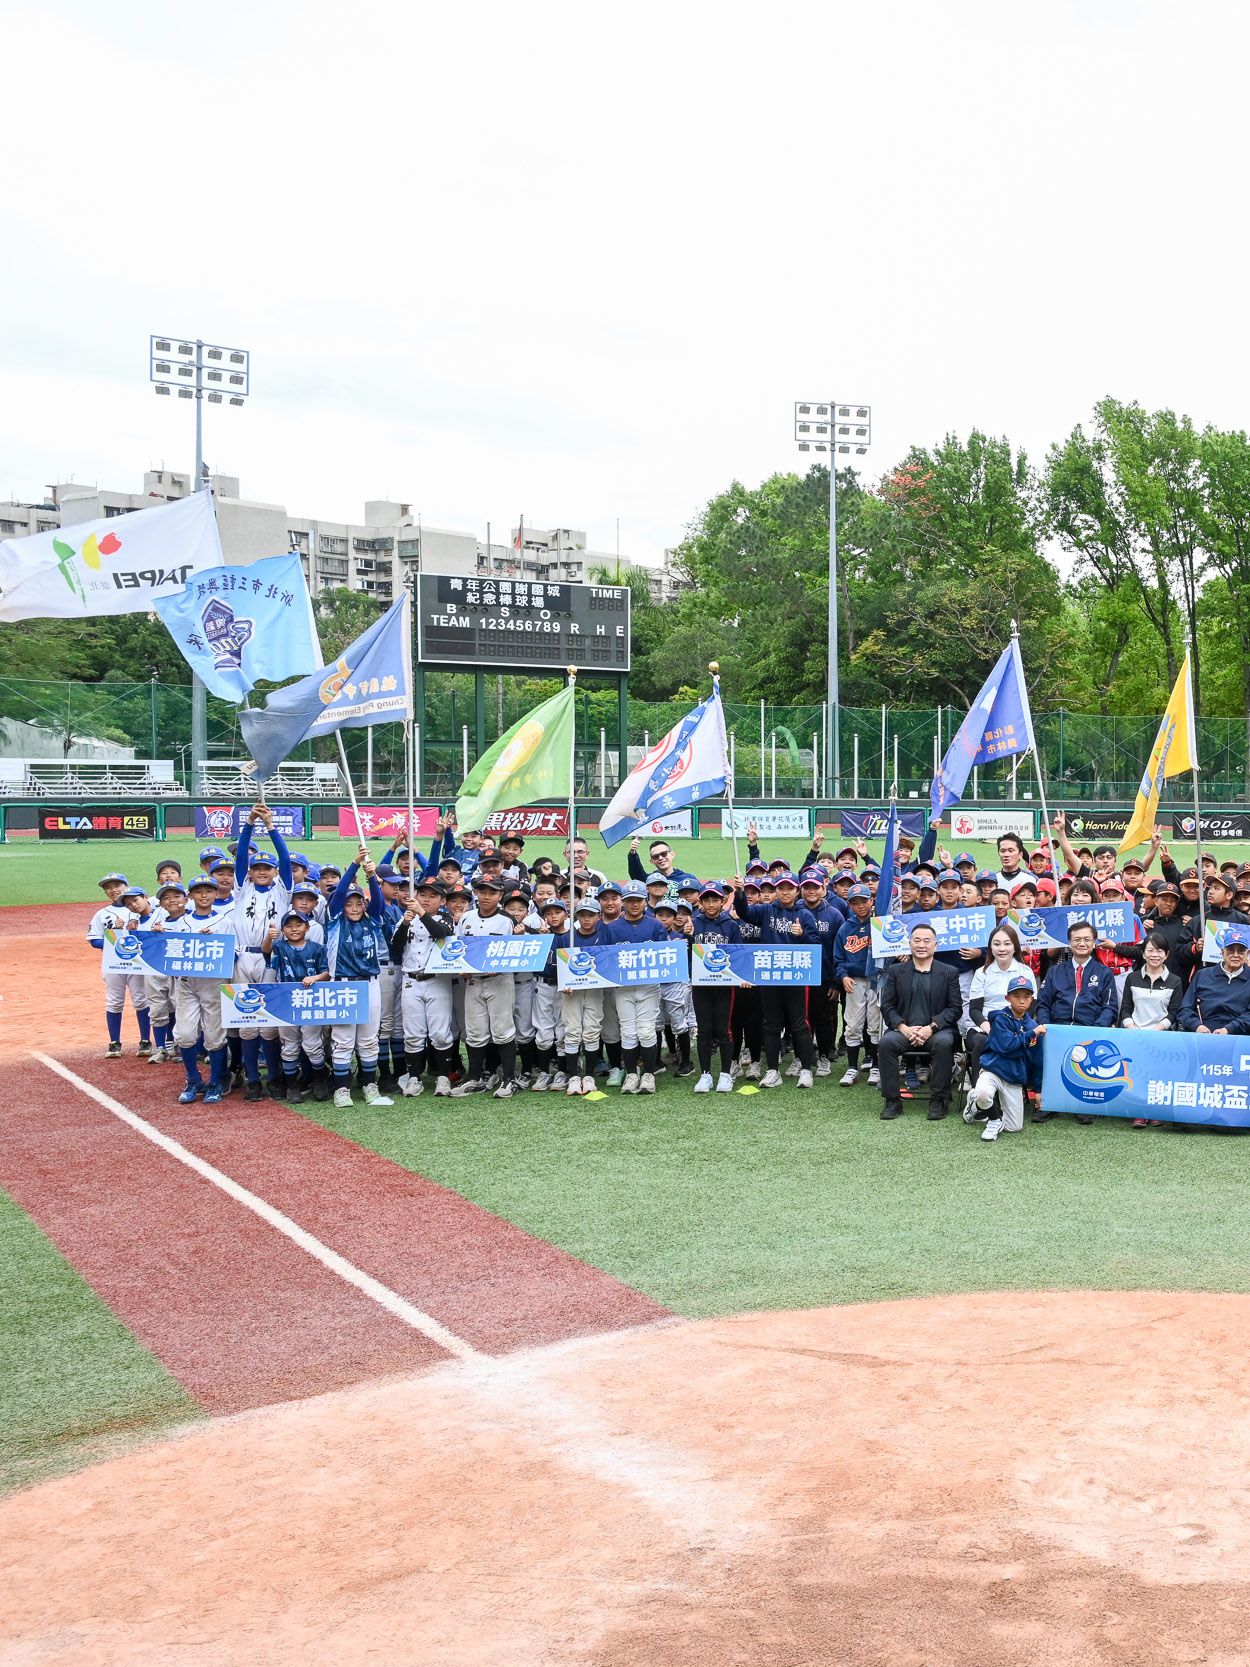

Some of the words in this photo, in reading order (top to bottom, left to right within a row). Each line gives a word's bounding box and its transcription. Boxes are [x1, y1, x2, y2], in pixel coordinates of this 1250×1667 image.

[449, 578, 560, 597] 青年公園謝國城
[590, 588, 622, 599] TIME
[466, 592, 545, 608] 紀念棒球場
[446, 604, 457, 614] B
[500, 606, 510, 618] S
[539, 609, 551, 620] O
[431, 614, 470, 628] TEAM
[570, 623, 580, 635] R
[596, 624, 605, 636] H
[616, 626, 624, 636] E
[484, 812, 563, 831] 黑松沙士
[1199, 821, 1232, 829] MOD
[1190, 869, 1196, 878] S
[604, 880, 613, 889] G
[929, 913, 985, 934] 臺中市
[938, 934, 979, 946] 大仁國小
[164, 938, 225, 960] 臺北市
[486, 940, 542, 958] 桃園市
[171, 960, 215, 972] 福林國小
[490, 958, 529, 968] 中平國小
[618, 948, 677, 969] 新竹市
[753, 950, 812, 969] 苗栗縣
[627, 968, 670, 981] 關東國小
[760, 971, 803, 981] 通霄國小
[291, 988, 358, 1008] 新北市
[1200, 1063, 1233, 1078] 115年
